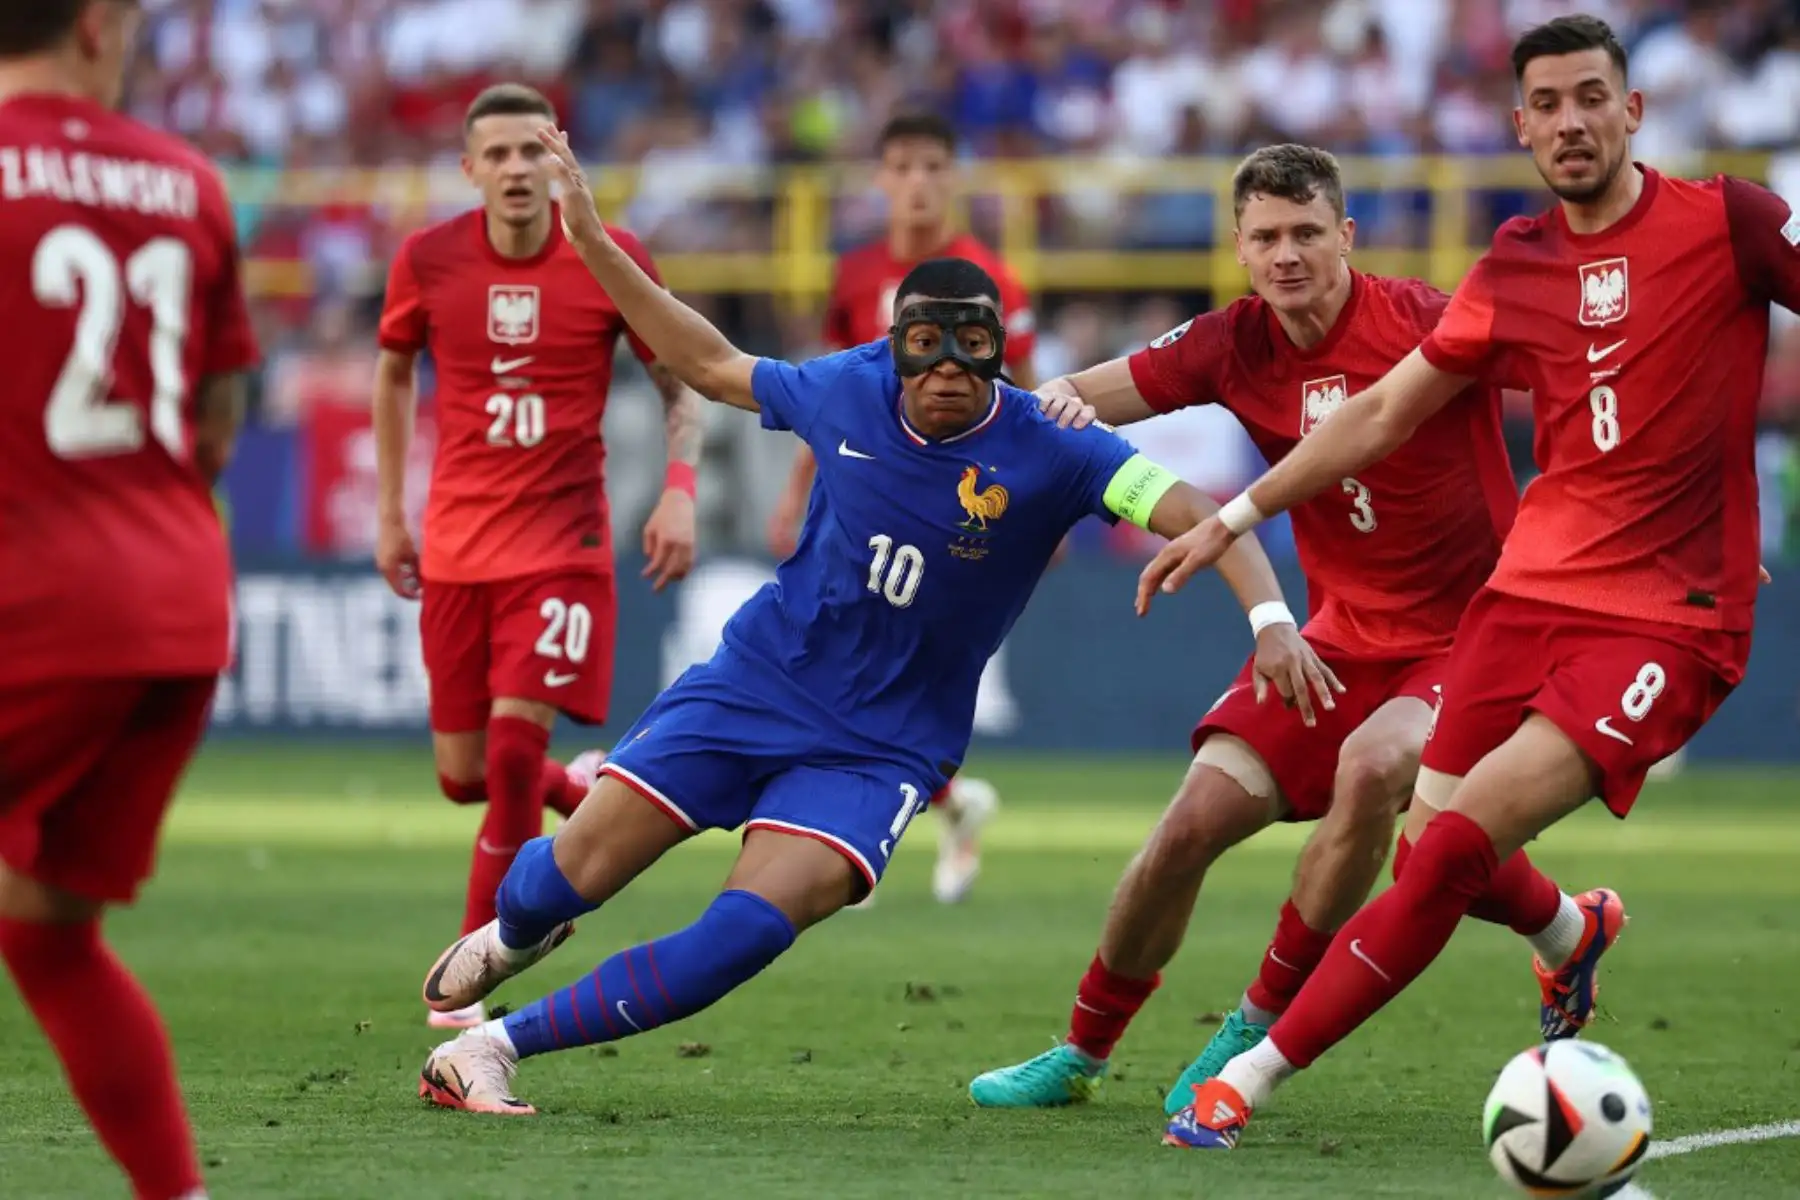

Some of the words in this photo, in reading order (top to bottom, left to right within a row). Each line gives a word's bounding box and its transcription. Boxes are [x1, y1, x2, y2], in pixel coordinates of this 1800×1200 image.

[31, 223, 193, 465] 21
[485, 393, 546, 447] 20
[1590, 386, 1620, 453] 8
[1126, 465, 1162, 504] RESPEC
[1342, 477, 1377, 533] 3
[867, 534, 925, 608] 10
[534, 597, 592, 664] 20
[1622, 662, 1666, 722] 8
[889, 782, 924, 840] 1
